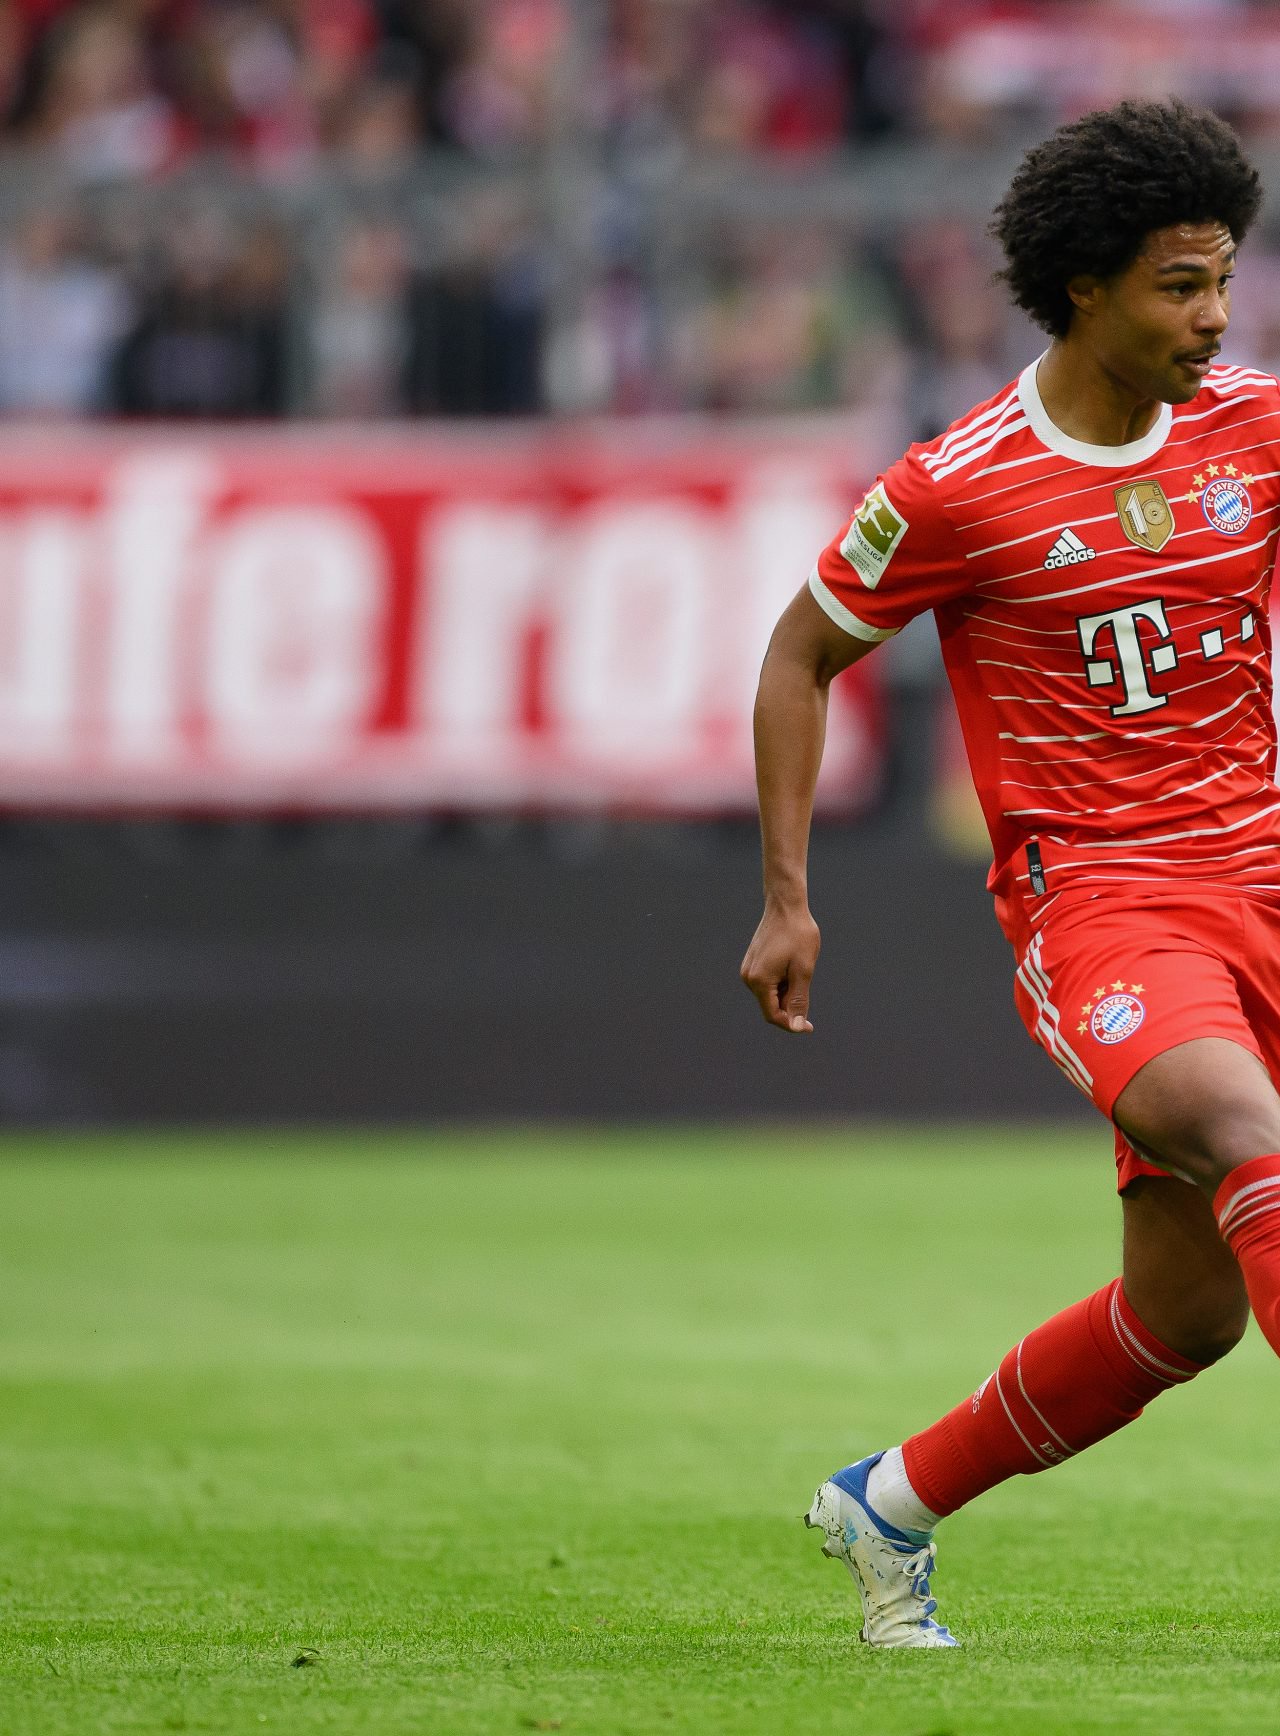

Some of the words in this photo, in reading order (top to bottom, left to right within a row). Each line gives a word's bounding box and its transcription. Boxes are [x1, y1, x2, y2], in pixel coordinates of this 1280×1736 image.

[1206, 495, 1214, 508] FC
[1210, 482, 1245, 499] BAYERN
[853, 521, 883, 563] UNDESLIGA
[1044, 548, 1096, 570] adidas
[1095, 1016, 1101, 1030] FC
[1098, 998, 1134, 1014] BAYERN
